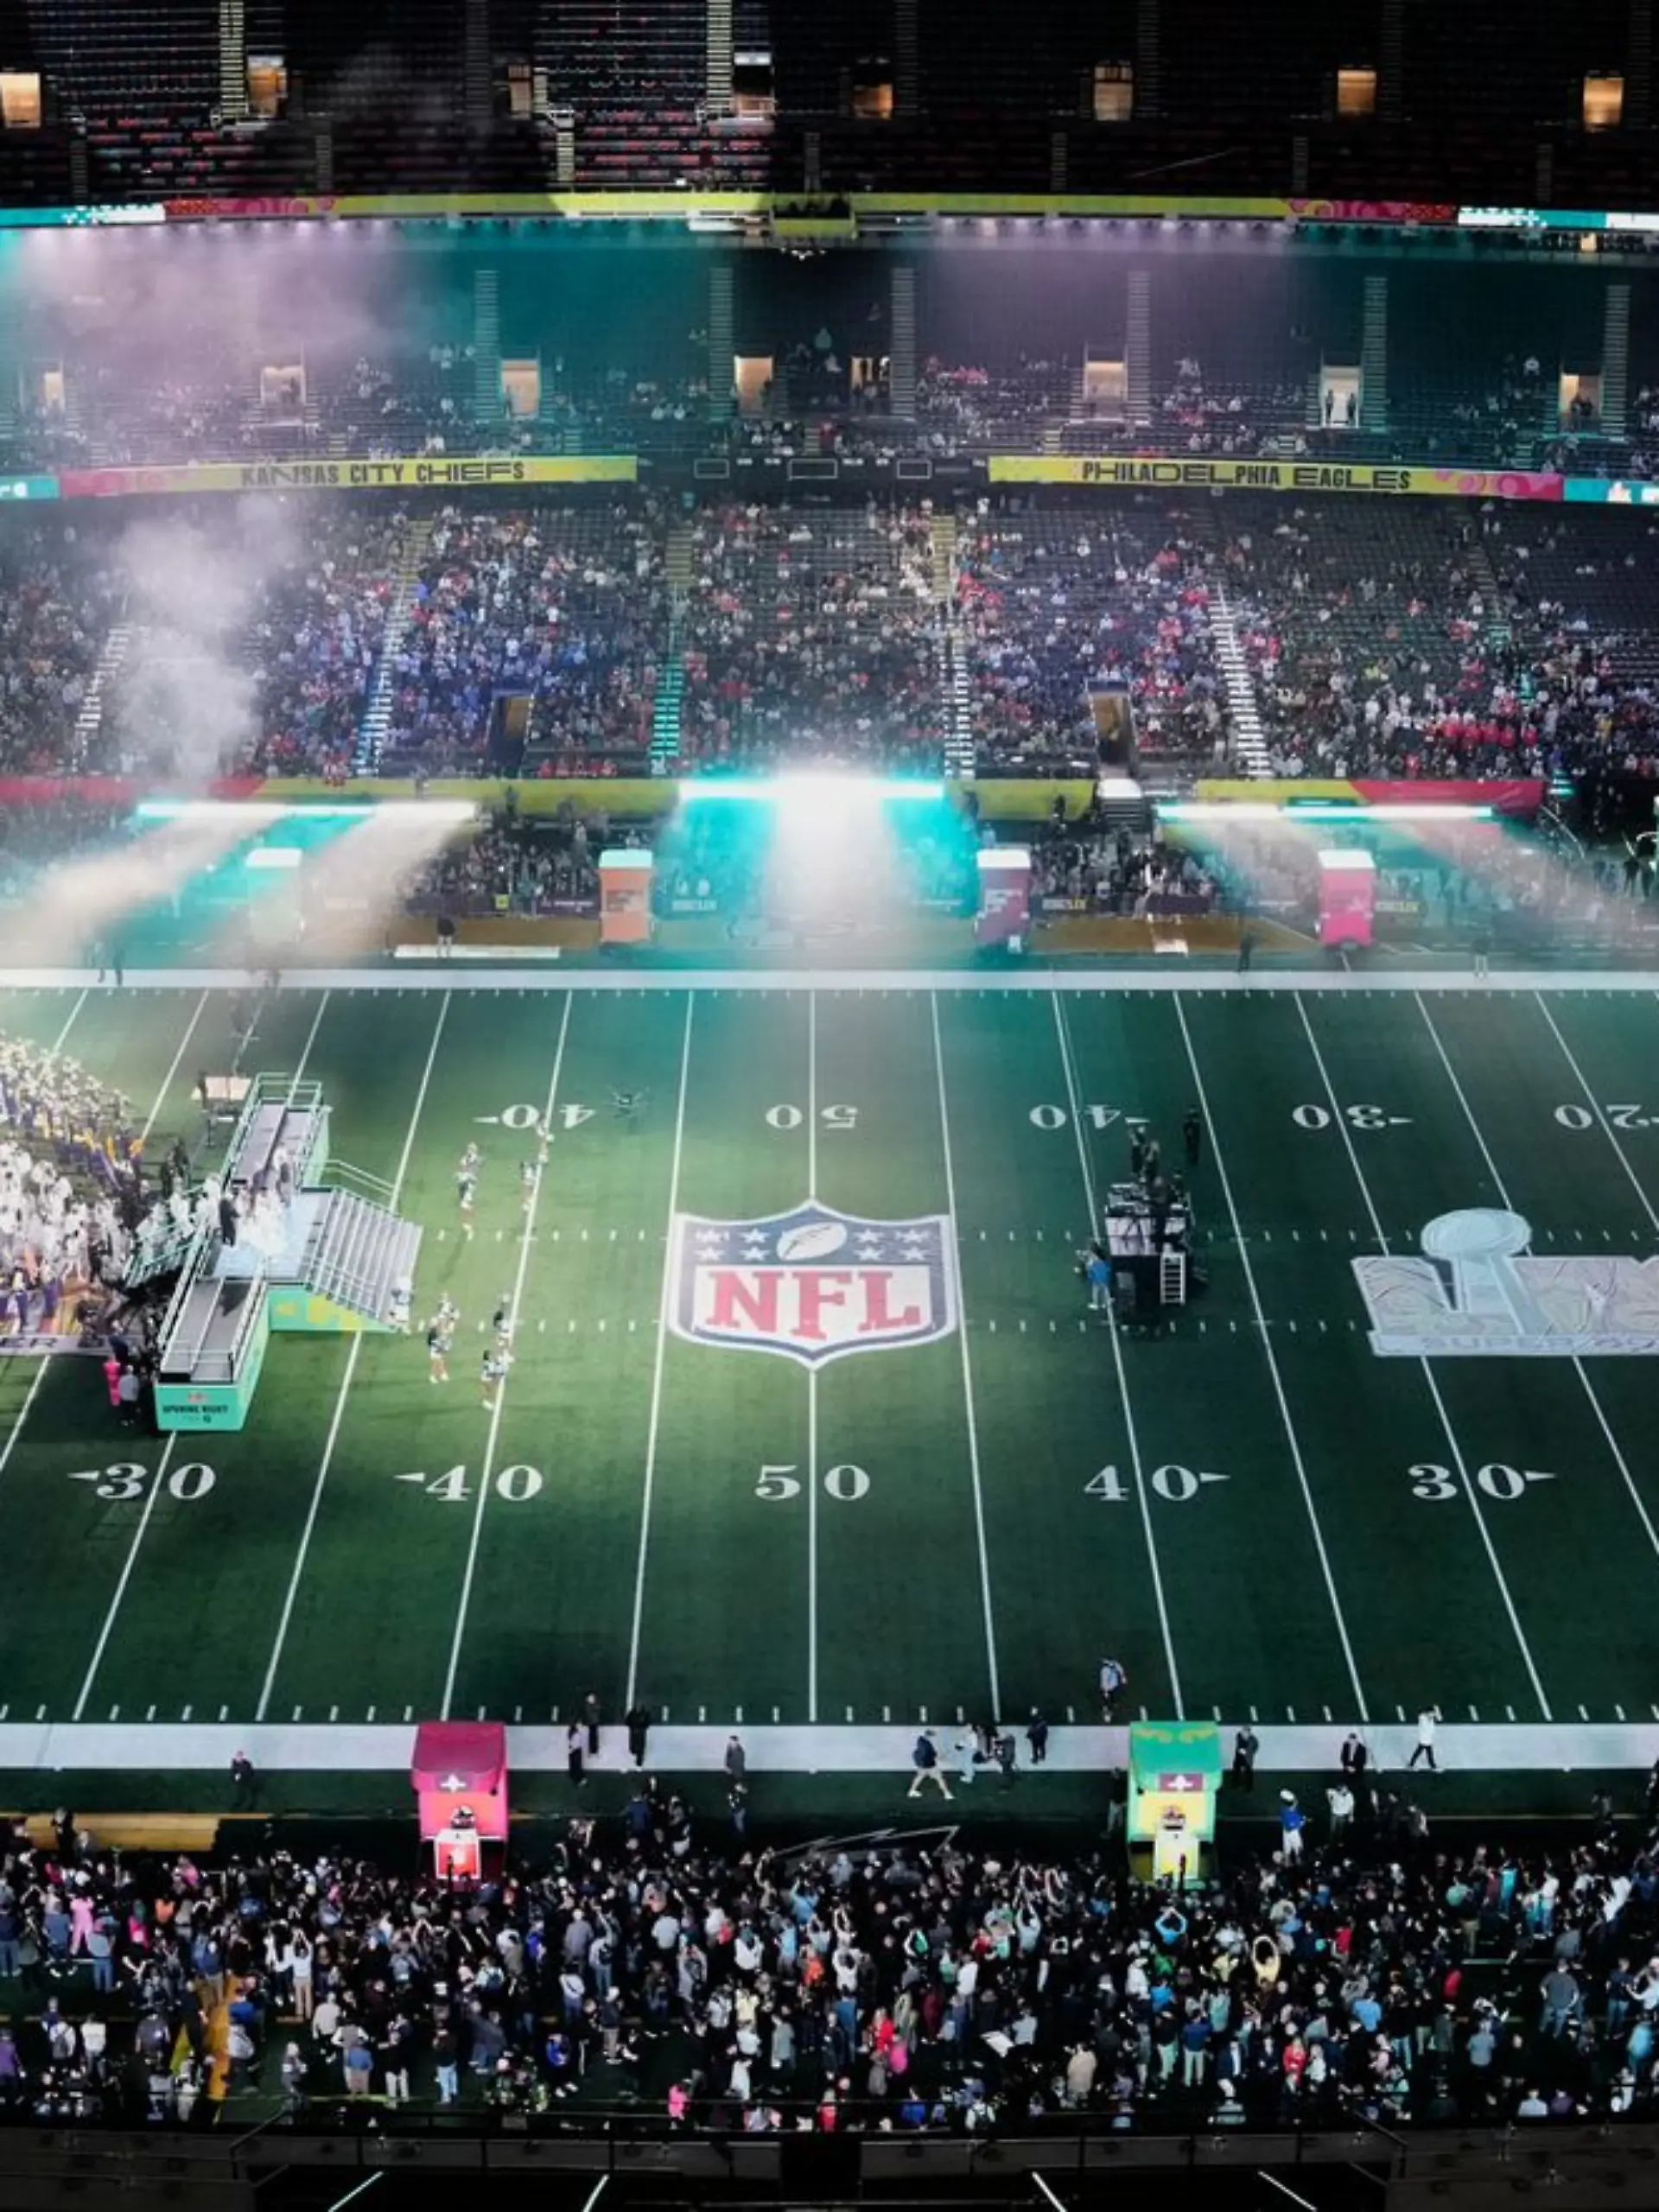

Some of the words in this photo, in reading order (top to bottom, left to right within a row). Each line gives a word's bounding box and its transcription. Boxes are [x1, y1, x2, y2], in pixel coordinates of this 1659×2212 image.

[241, 465, 339, 486] KANSAS
[349, 463, 404, 484] CITY
[416, 461, 525, 482] CHIEFS
[1082, 461, 1281, 486] PHILADELPHIA
[1295, 467, 1411, 489] EAGLES
[705, 1269, 921, 1340] NFL
